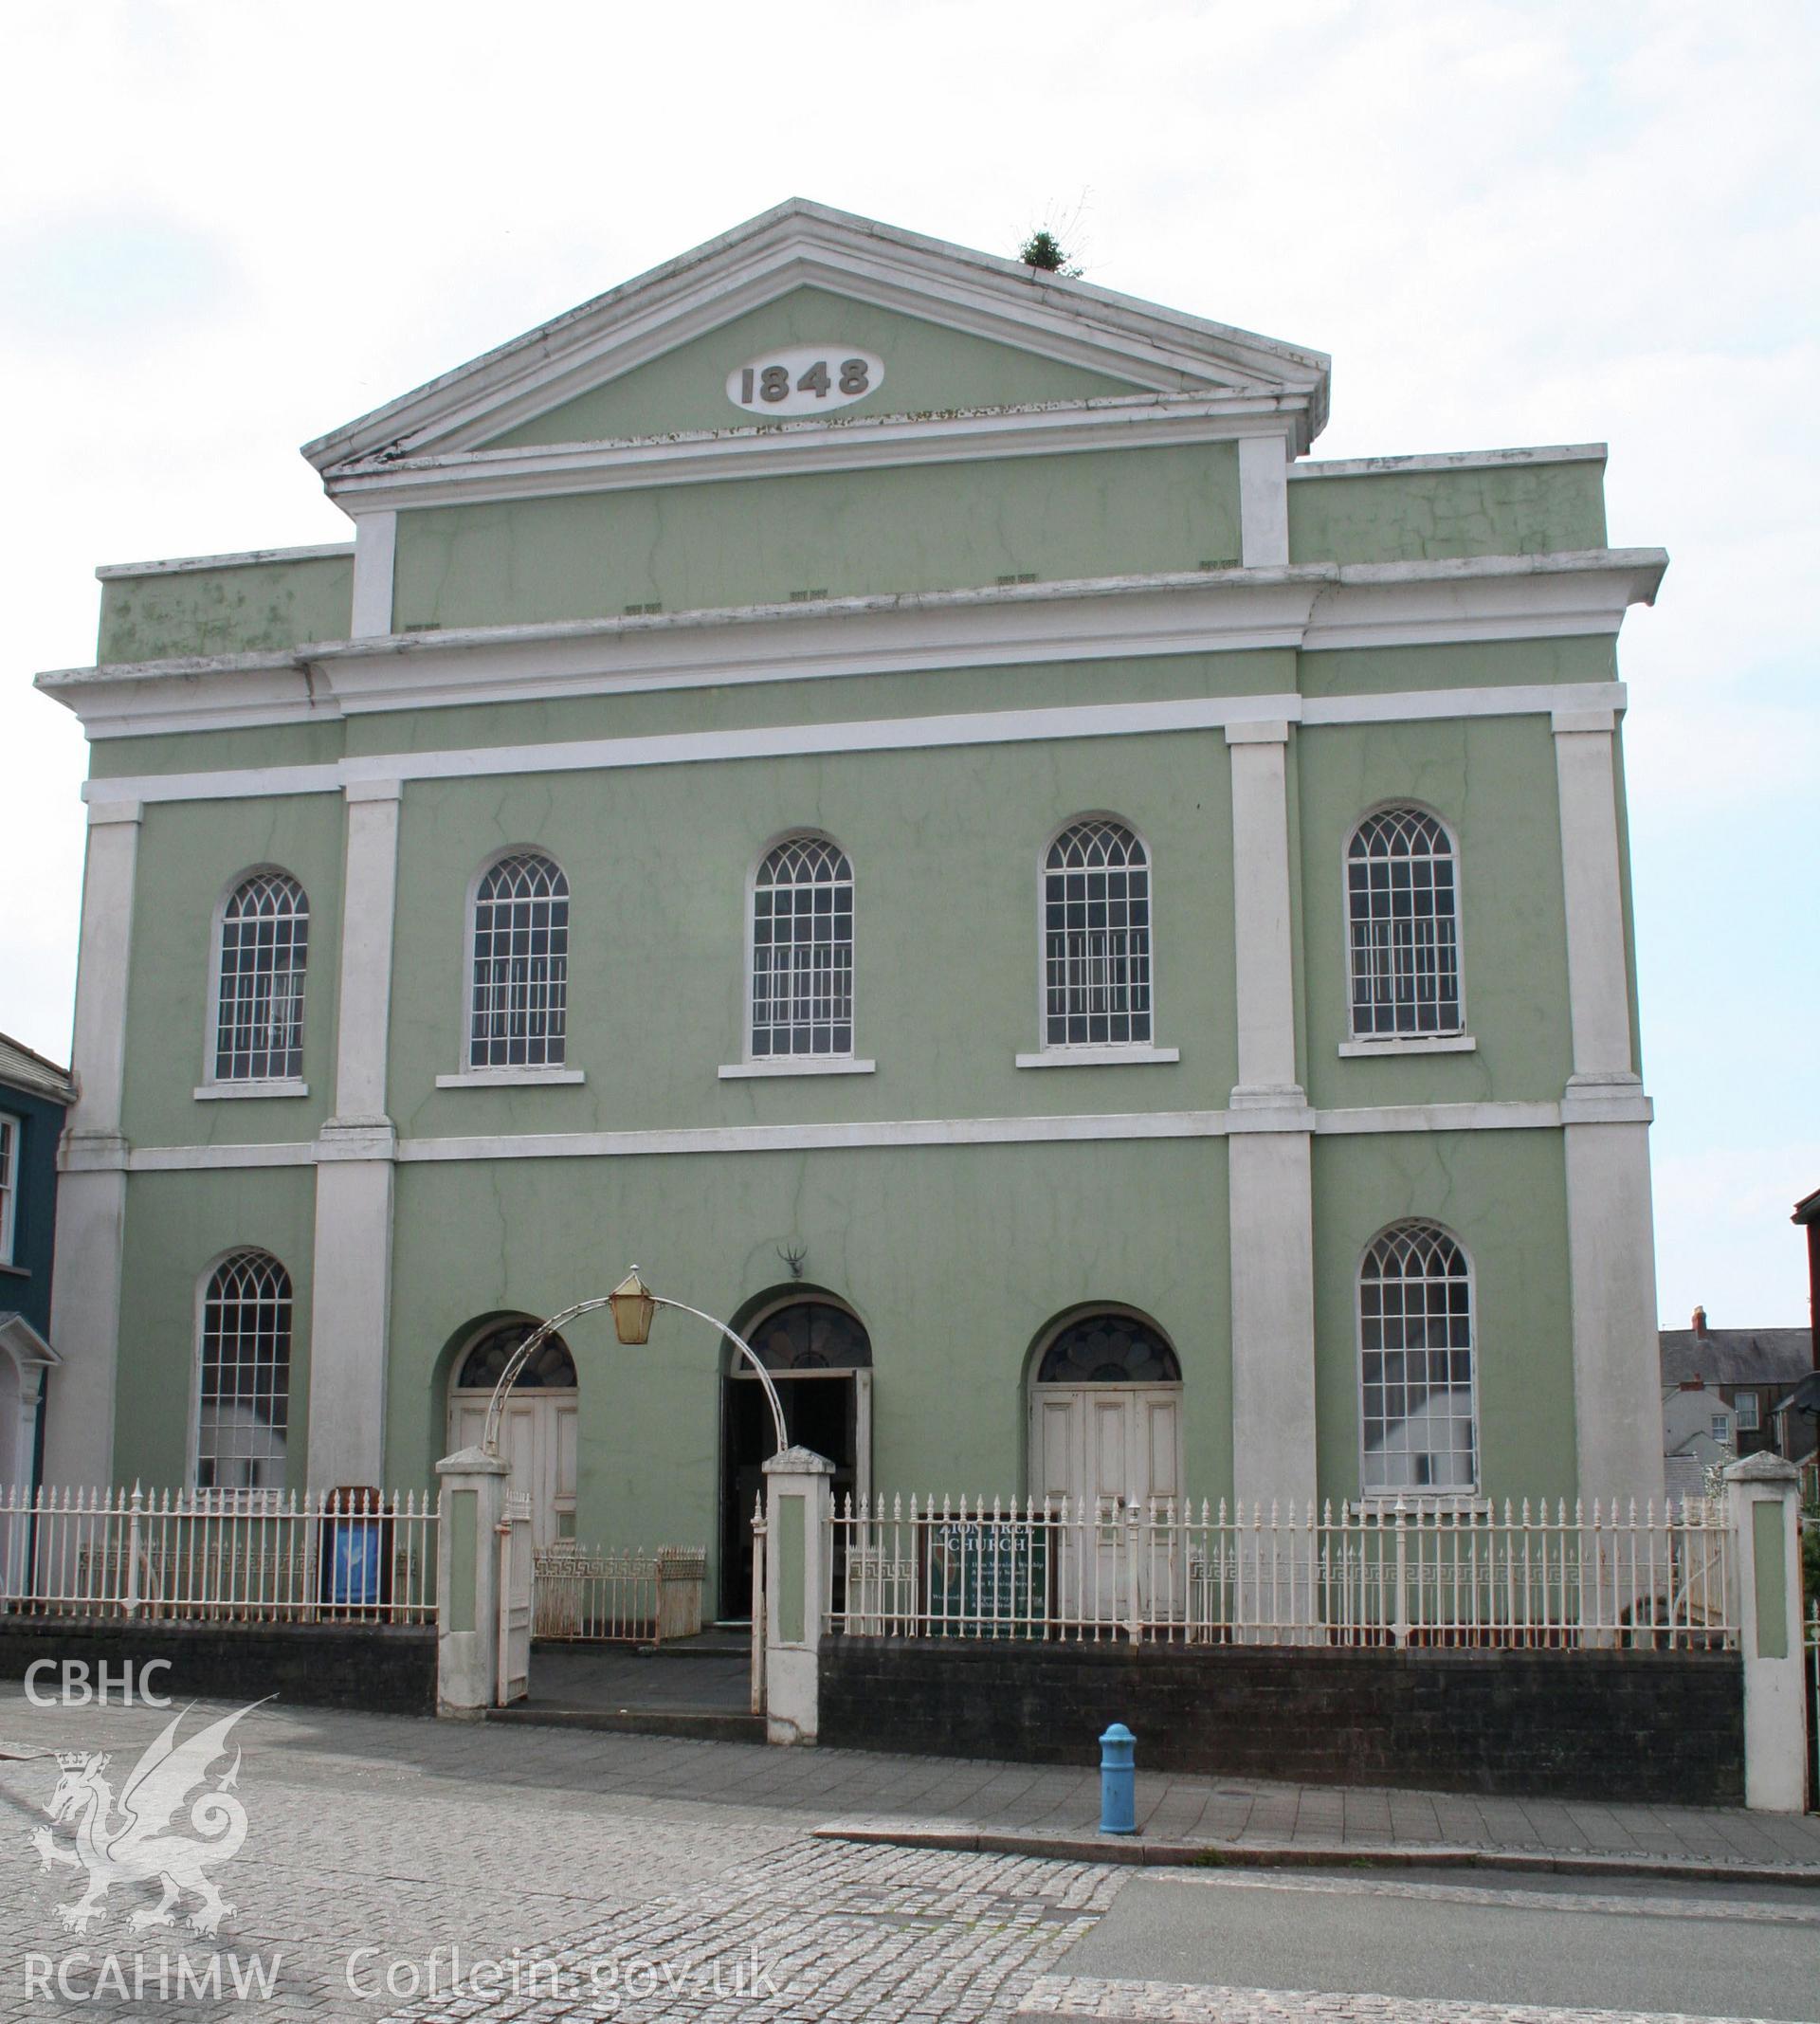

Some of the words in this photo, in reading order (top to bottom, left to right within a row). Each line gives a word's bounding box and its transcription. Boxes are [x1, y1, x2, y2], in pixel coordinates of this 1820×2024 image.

[741, 357, 869, 405] 1848
[939, 1521, 982, 1534] ZION
[948, 1538, 1026, 1551] CHURCH
